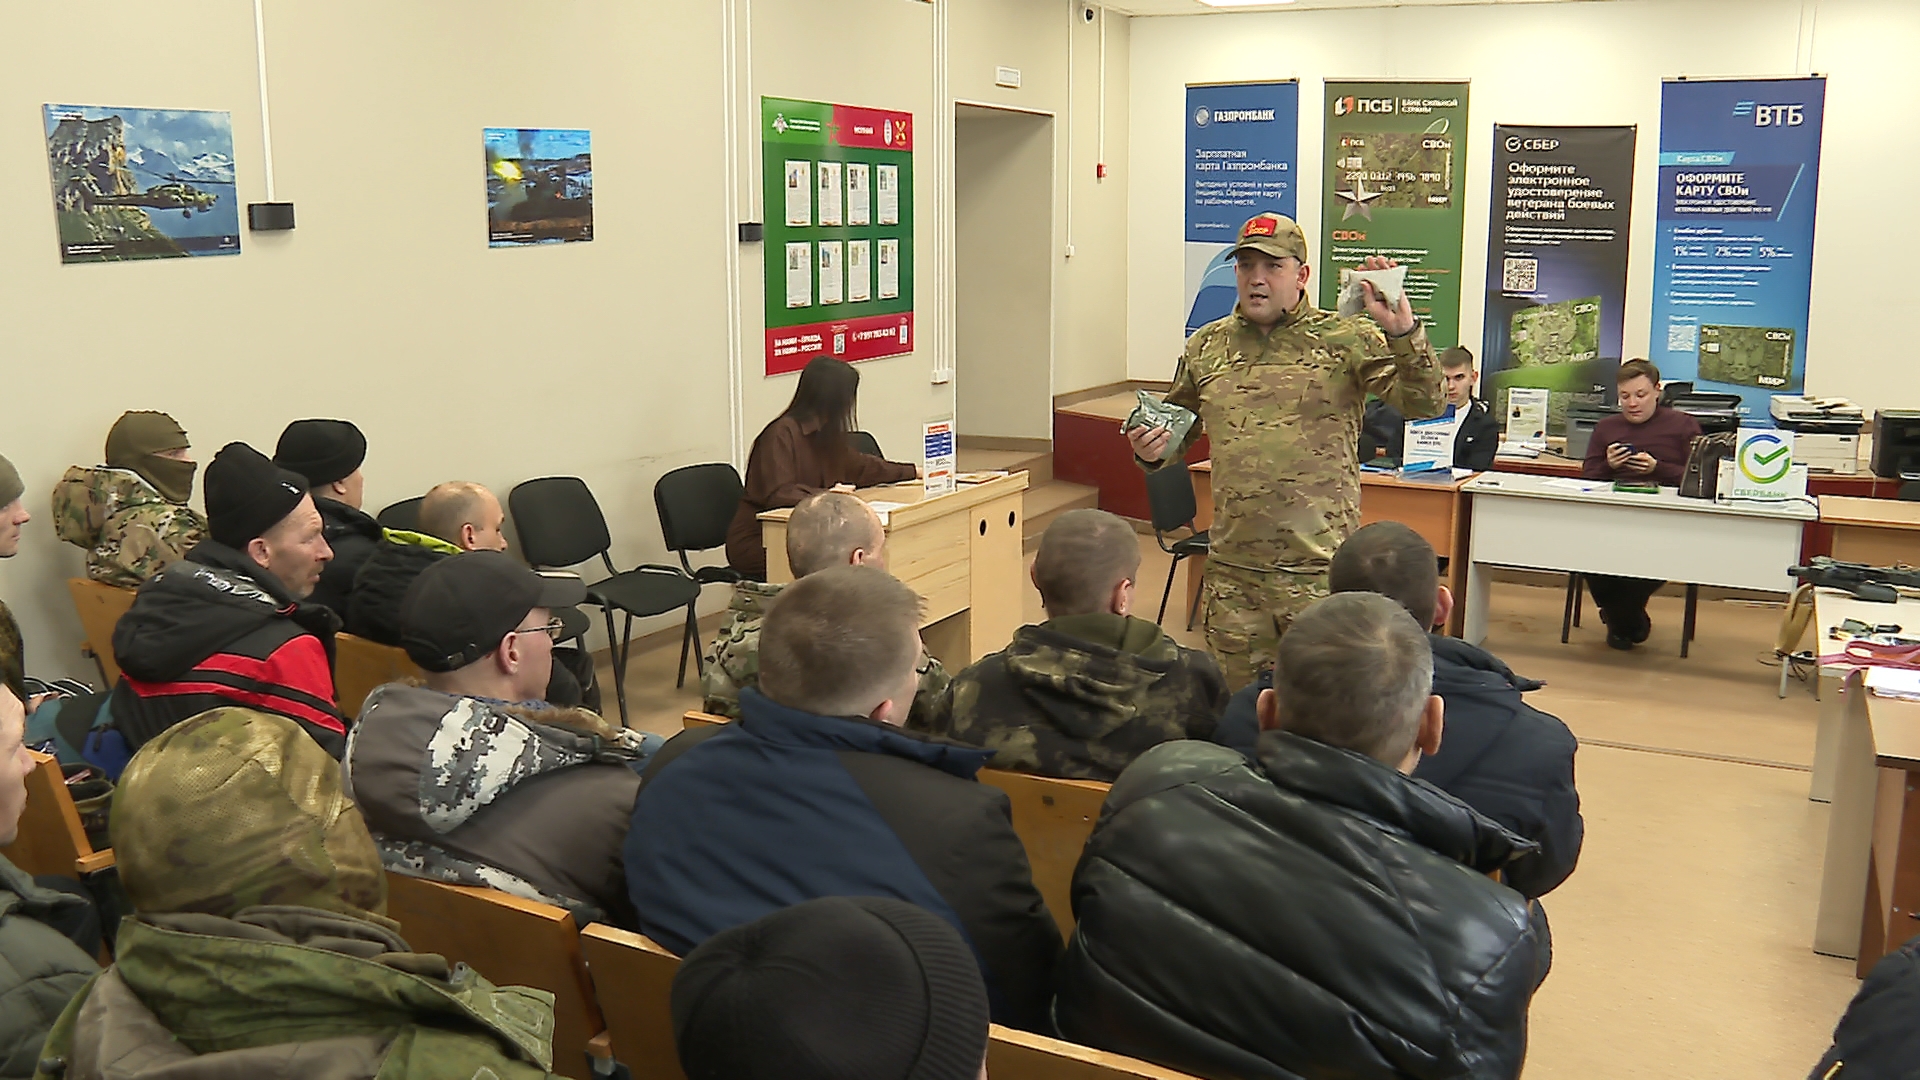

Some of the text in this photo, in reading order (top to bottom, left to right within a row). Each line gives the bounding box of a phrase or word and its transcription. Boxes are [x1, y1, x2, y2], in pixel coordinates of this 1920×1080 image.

[1357, 99, 1393, 113] ПСБ
[1401, 99, 1421, 107] БАНК
[1214, 109, 1275, 122] ГАЗПРОМБАНК
[1755, 105, 1804, 126] ВТБ
[1523, 140, 1560, 150] СБЕР
[1195, 149, 1247, 160] Зарплатная
[1195, 160, 1288, 172] карта Газпромбанка
[1508, 162, 1576, 176] Оформите
[1507, 176, 1591, 188] электронное
[1676, 173, 1745, 184] ОФОРМИТЕ
[1507, 188, 1604, 200] удостоверение
[1676, 186, 1749, 196] КАРТУ СВОи
[1506, 198, 1616, 210] ветерана боевых
[1505, 209, 1565, 221] действий
[1673, 246, 1688, 257] 1%
[1715, 246, 1732, 257] 2%
[1759, 247, 1777, 258] 5%
